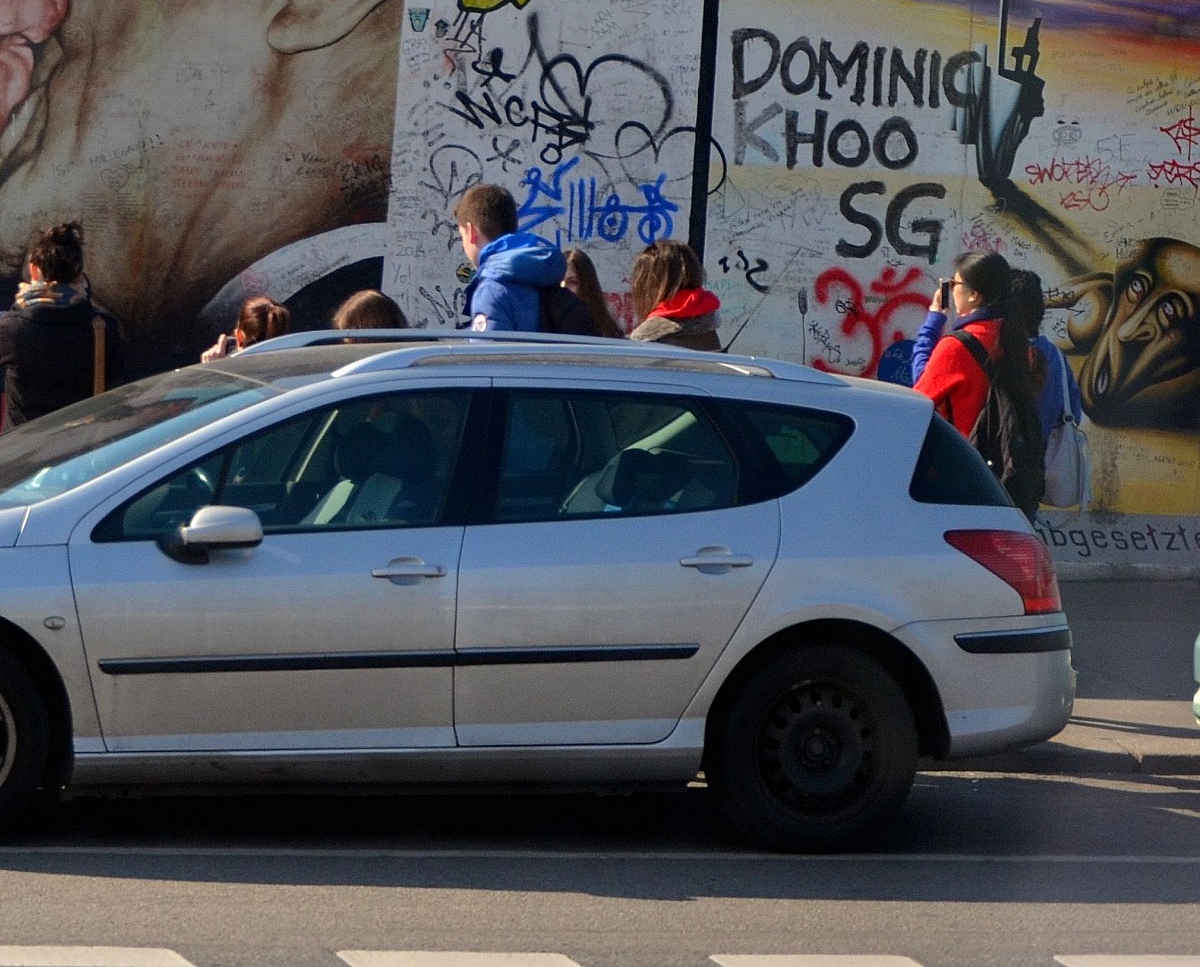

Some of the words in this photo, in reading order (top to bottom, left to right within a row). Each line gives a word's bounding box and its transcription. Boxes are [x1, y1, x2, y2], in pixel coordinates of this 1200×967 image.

[731, 27, 983, 110] DOMINIC
[732, 100, 919, 171] KHOO
[835, 180, 948, 265] SG
